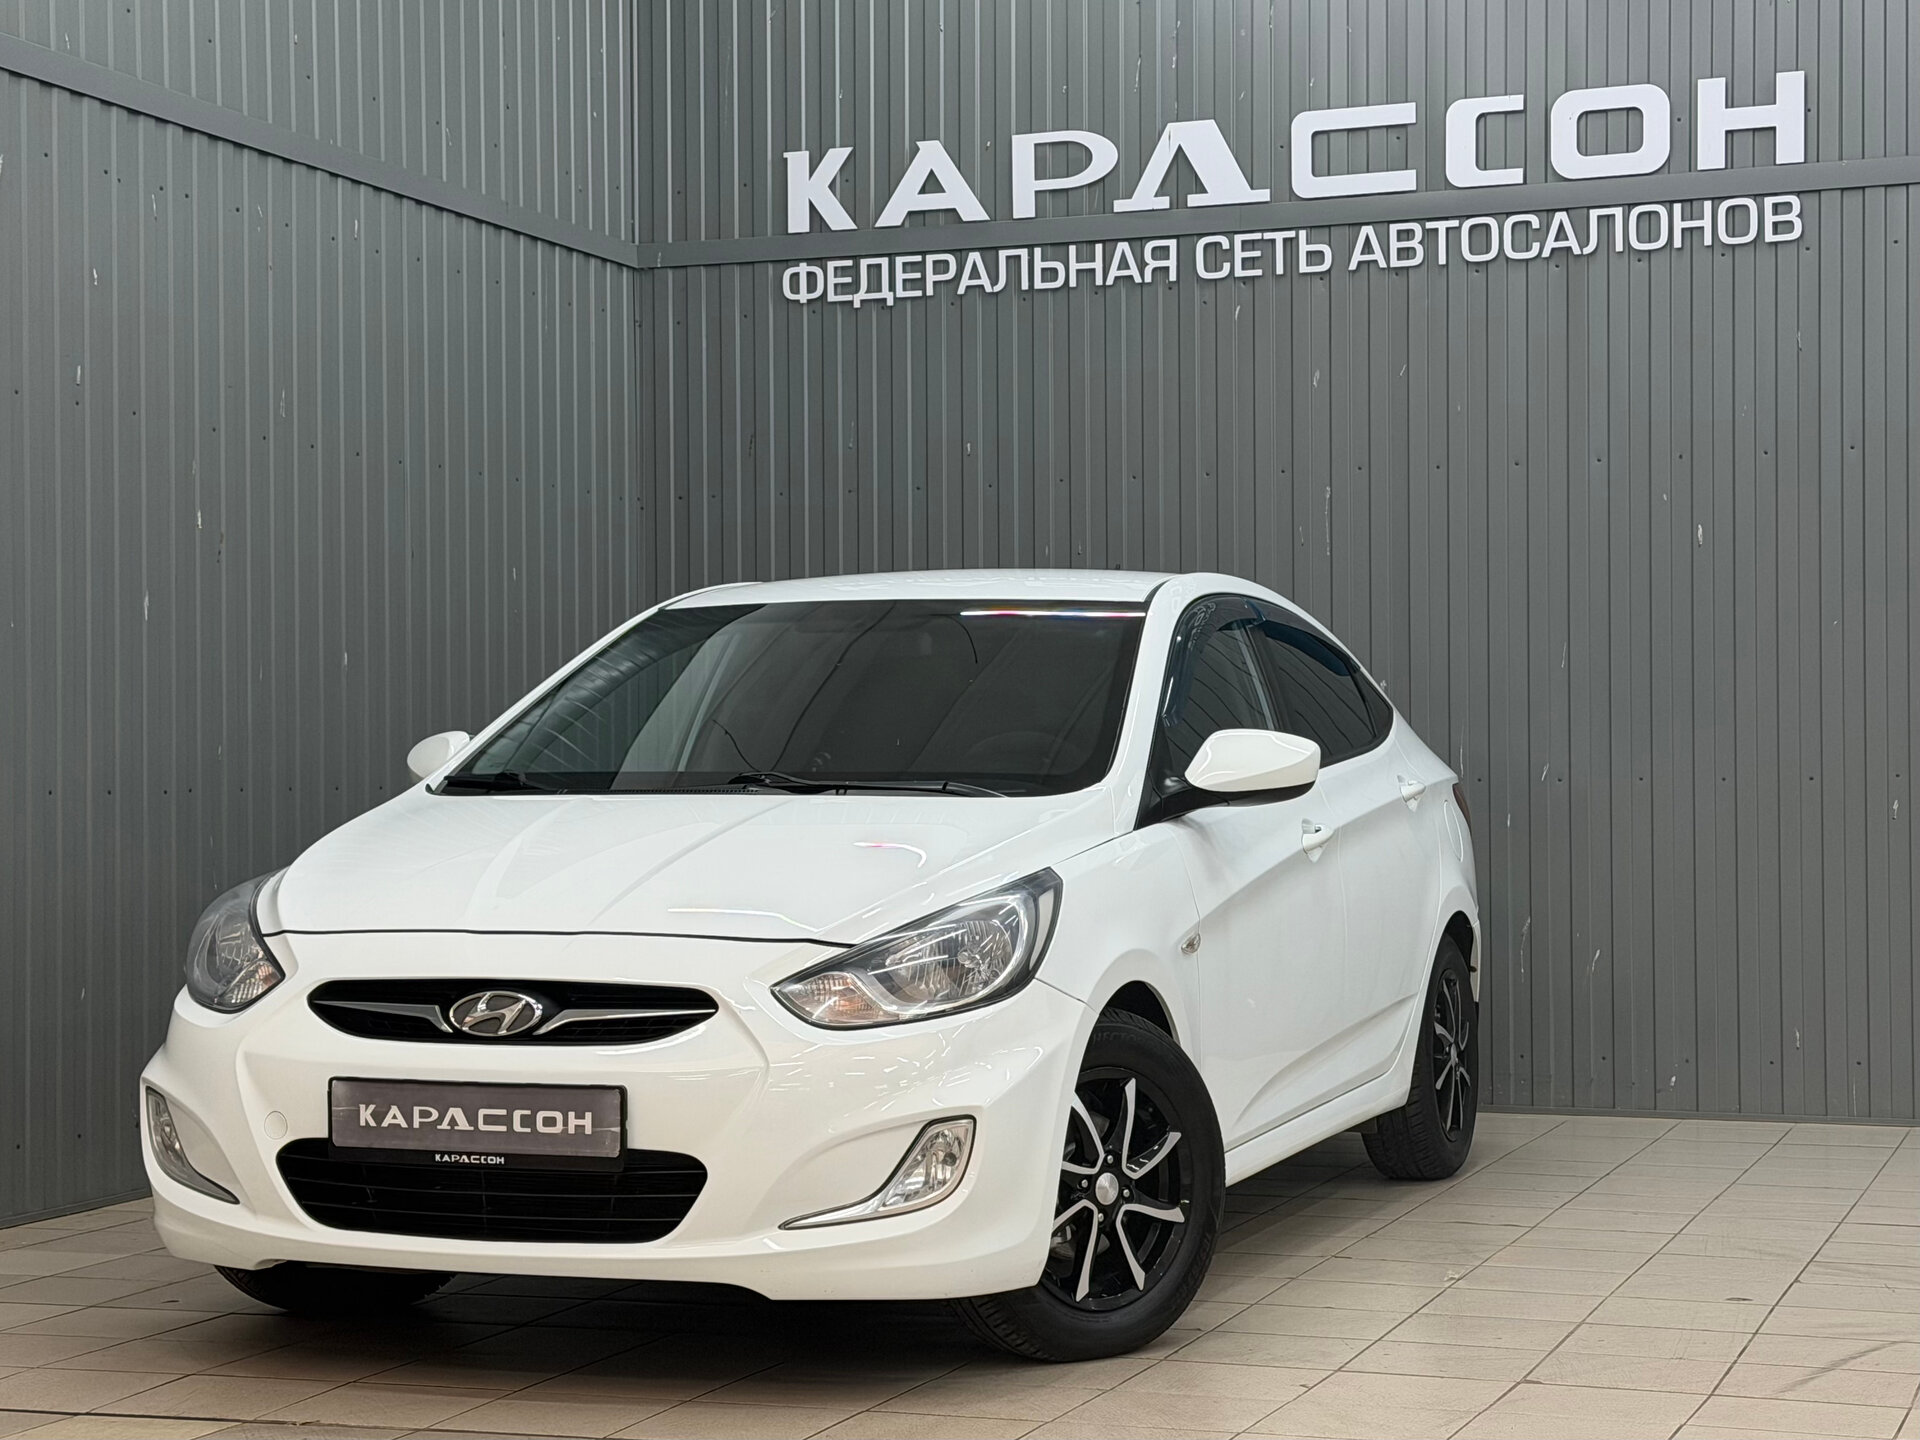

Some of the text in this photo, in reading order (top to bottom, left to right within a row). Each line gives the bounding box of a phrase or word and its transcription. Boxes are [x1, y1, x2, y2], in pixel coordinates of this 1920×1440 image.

[782, 195, 1803, 308] ФЕДЕРАЛЬНАЯ СЕТЬ АВТОСАЛОНОВ
